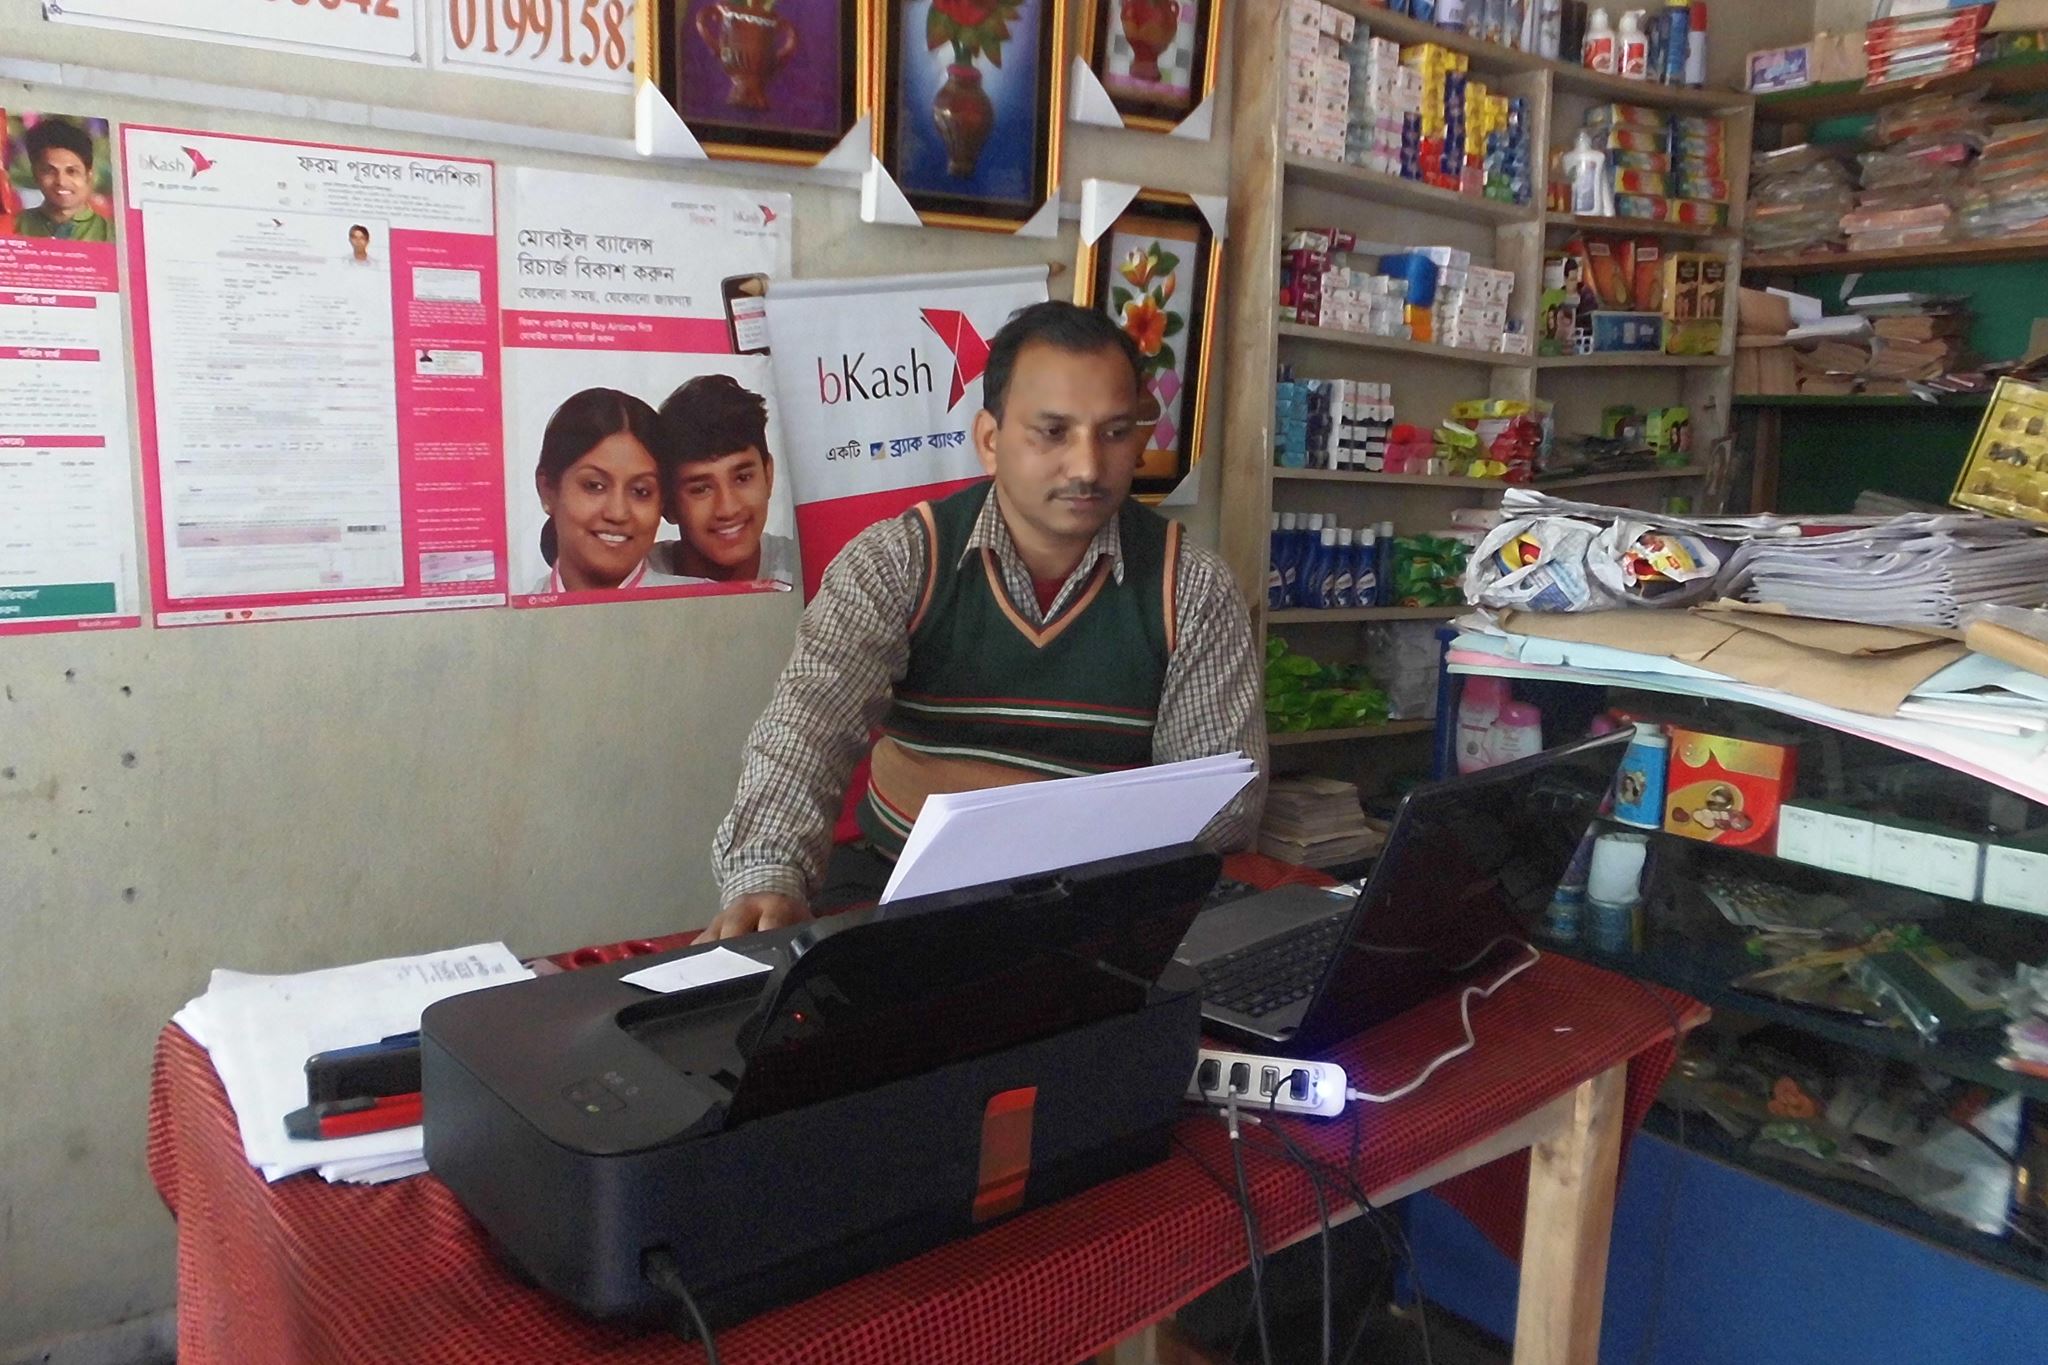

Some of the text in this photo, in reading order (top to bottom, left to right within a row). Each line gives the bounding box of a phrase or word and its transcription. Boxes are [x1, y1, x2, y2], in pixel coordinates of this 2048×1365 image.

[449, 0, 635, 72] 0199158
[138, 153, 185, 172] bKash
[297, 155, 481, 188] ফরম পূরণের নির্দেশিকা
[517, 226, 588, 251] মোবাইল
[517, 251, 570, 278] রিচার্জ
[574, 255, 626, 281] বিকাশ
[632, 264, 675, 283] করুন
[817, 347, 933, 405] bKash
[825, 430, 966, 461] একটি ব্র্যাক ব্যাংক
